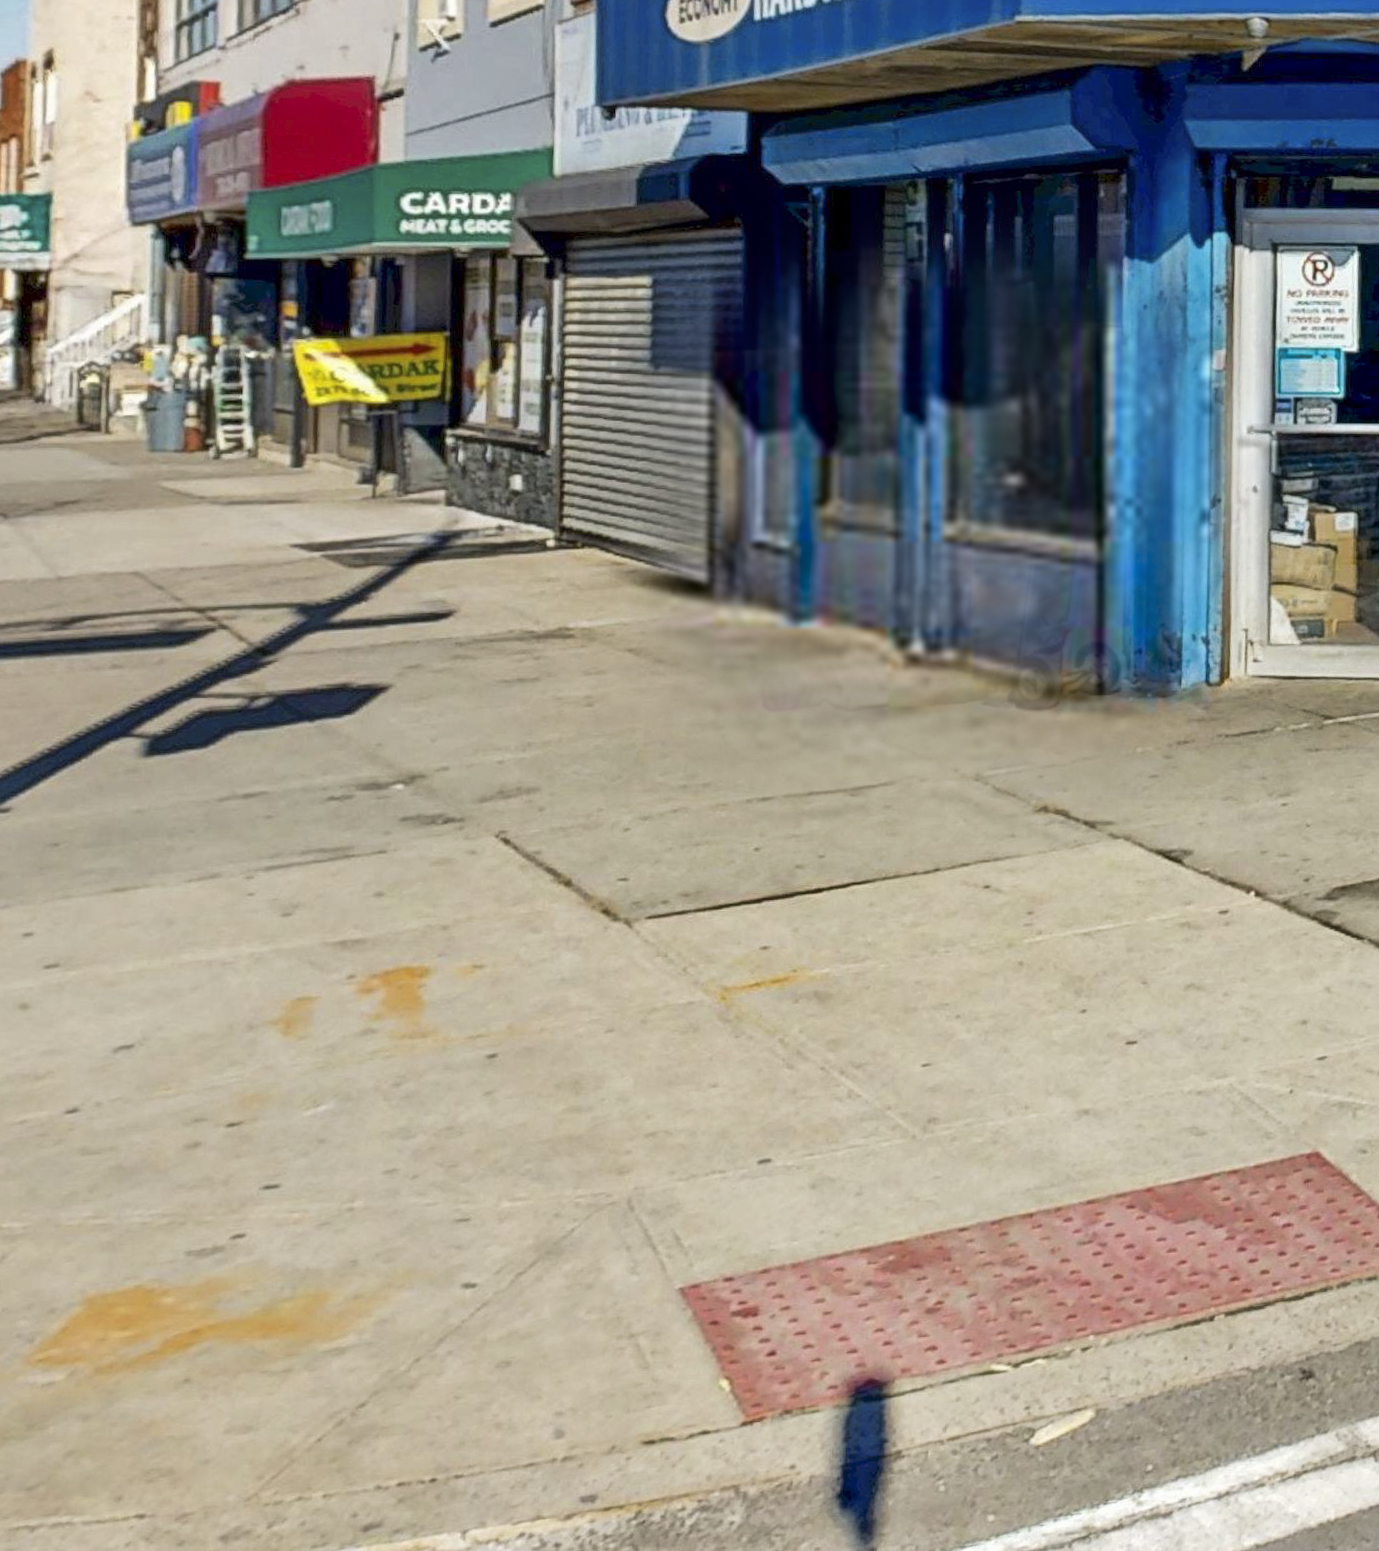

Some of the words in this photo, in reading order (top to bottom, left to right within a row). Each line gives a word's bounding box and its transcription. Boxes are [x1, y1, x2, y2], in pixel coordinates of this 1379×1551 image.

[399, 219, 447, 235] MEAT
[1286, 289, 1303, 298] NO
[1306, 288, 1350, 298] PARKING
